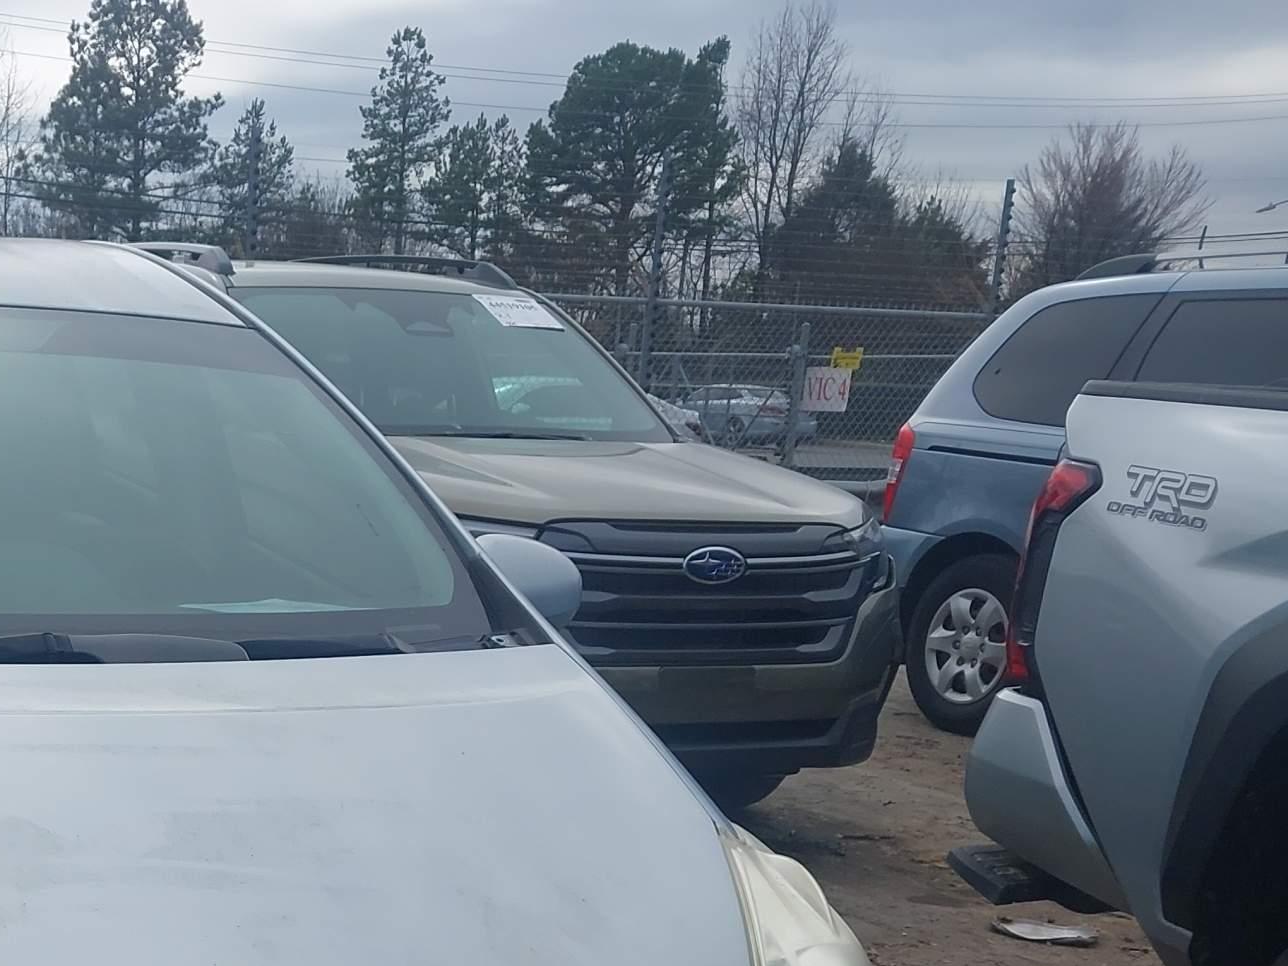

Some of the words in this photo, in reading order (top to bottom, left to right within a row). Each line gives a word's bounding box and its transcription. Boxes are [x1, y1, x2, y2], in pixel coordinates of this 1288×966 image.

[1127, 464, 1219, 512] TRD
[1106, 501, 1148, 519] OFF
[1149, 509, 1208, 531] ROAD
